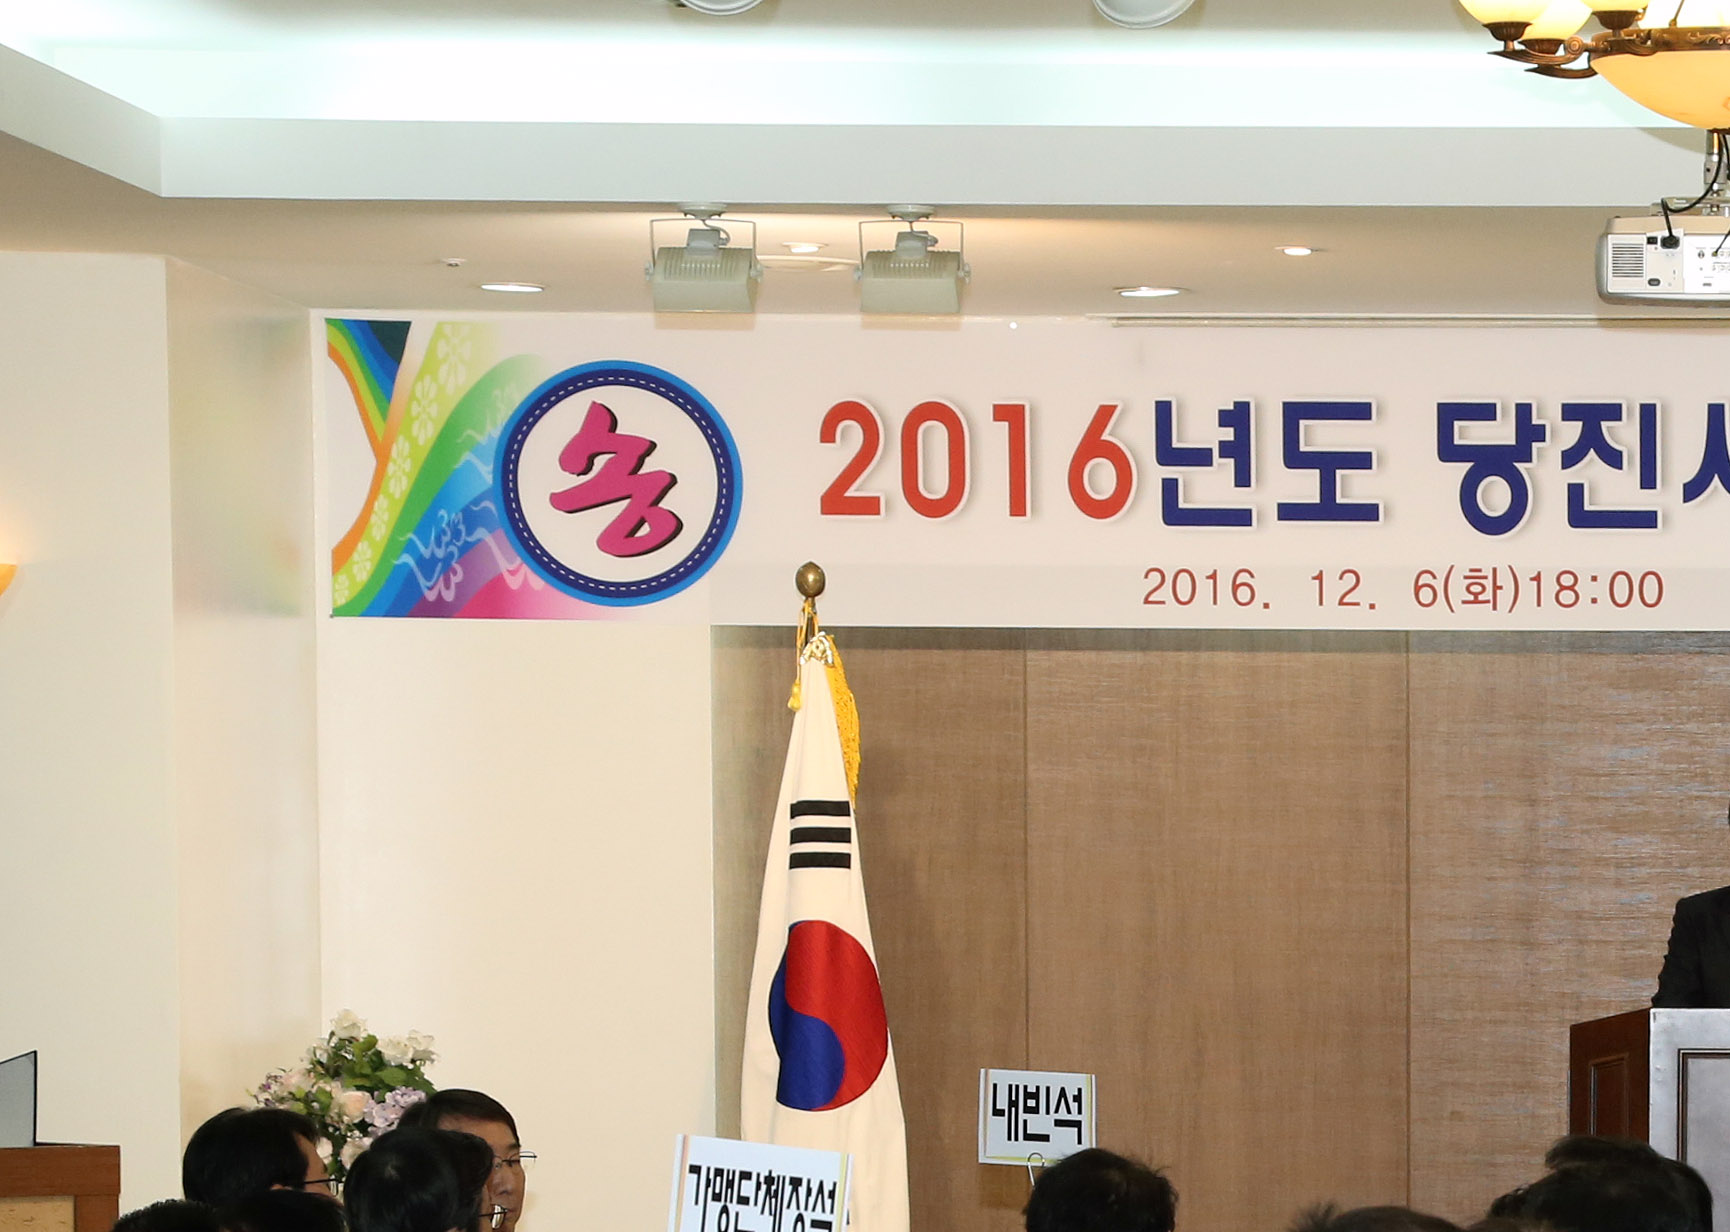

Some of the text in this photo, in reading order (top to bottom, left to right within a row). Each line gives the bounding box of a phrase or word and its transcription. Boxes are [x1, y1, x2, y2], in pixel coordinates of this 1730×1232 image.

[550, 401, 684, 557] 송
[820, 400, 1383, 531] 2016년도
[1143, 565, 1664, 613] 2016. 12. 6(화)18:00
[991, 1082, 1083, 1146] 내빈석
